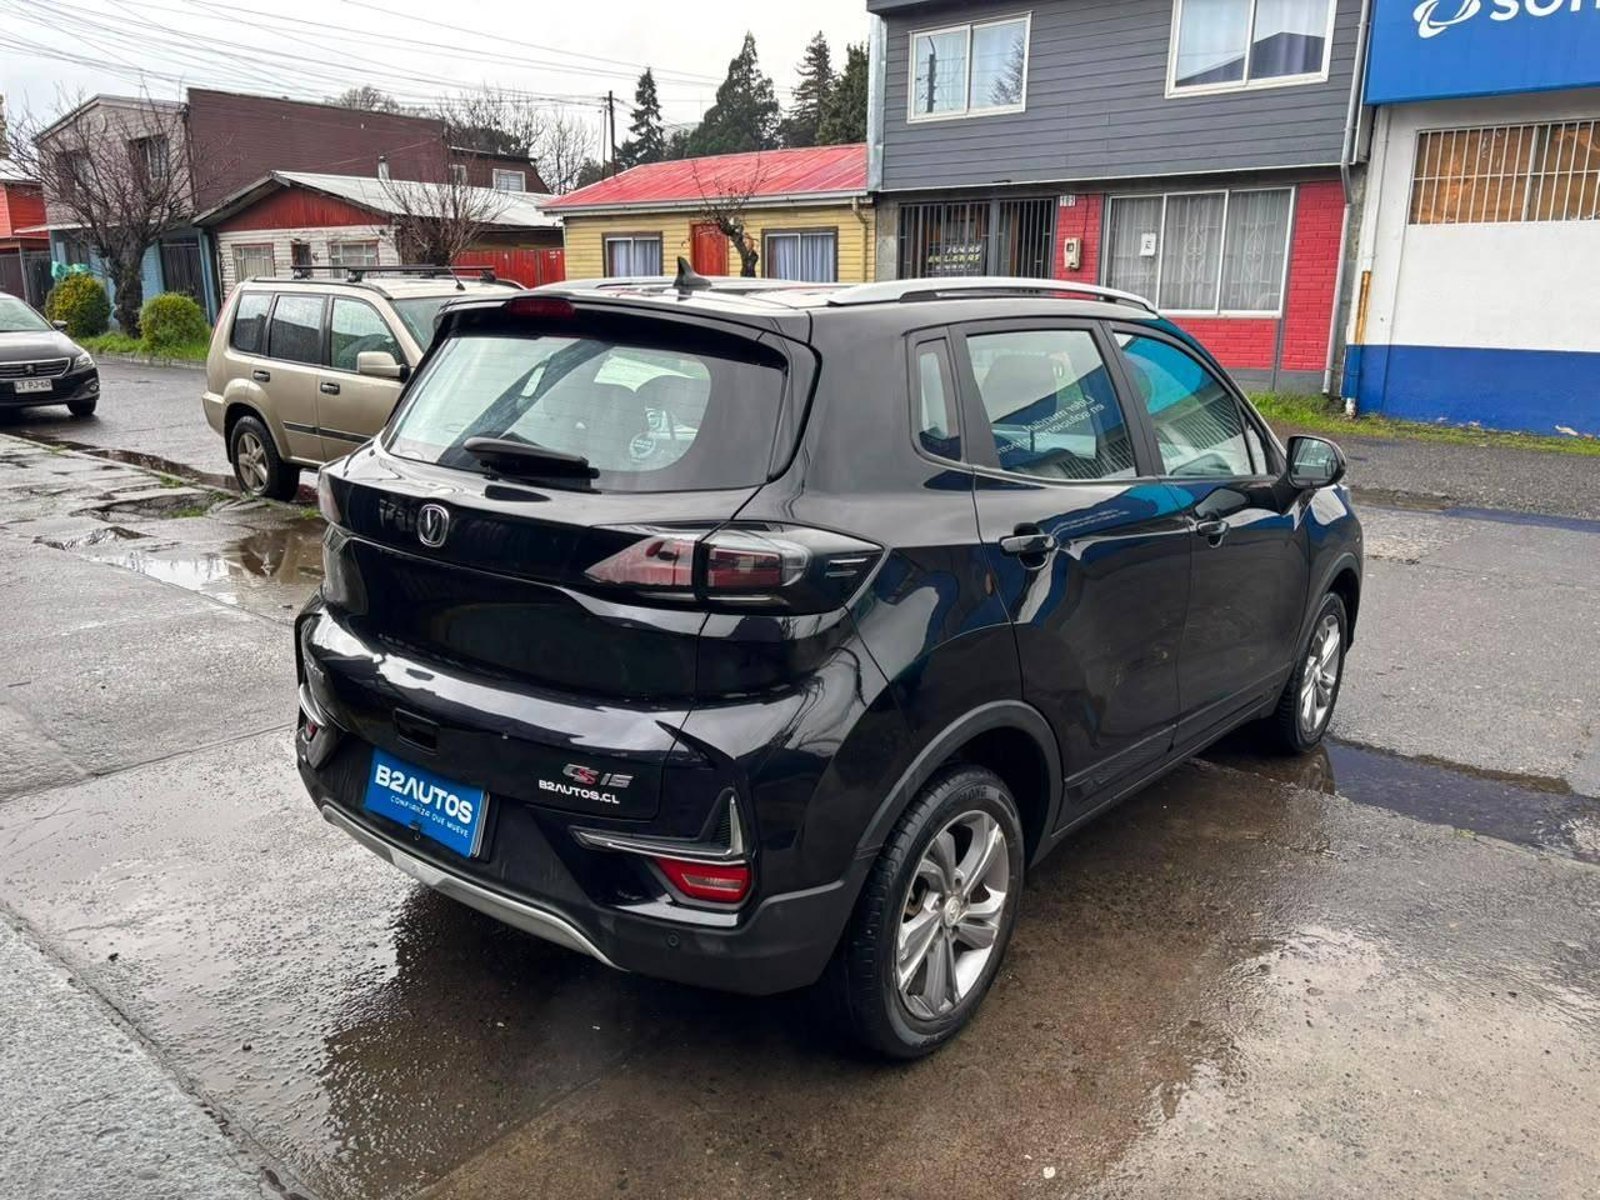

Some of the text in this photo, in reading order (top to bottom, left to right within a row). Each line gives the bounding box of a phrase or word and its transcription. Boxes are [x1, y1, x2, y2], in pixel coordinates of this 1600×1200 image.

[375, 764, 474, 824] B2AUTOS
[538, 779, 620, 804] B2AUTOS.CL
[390, 795, 469, 838] CONFIANZA QUE MUEVE
